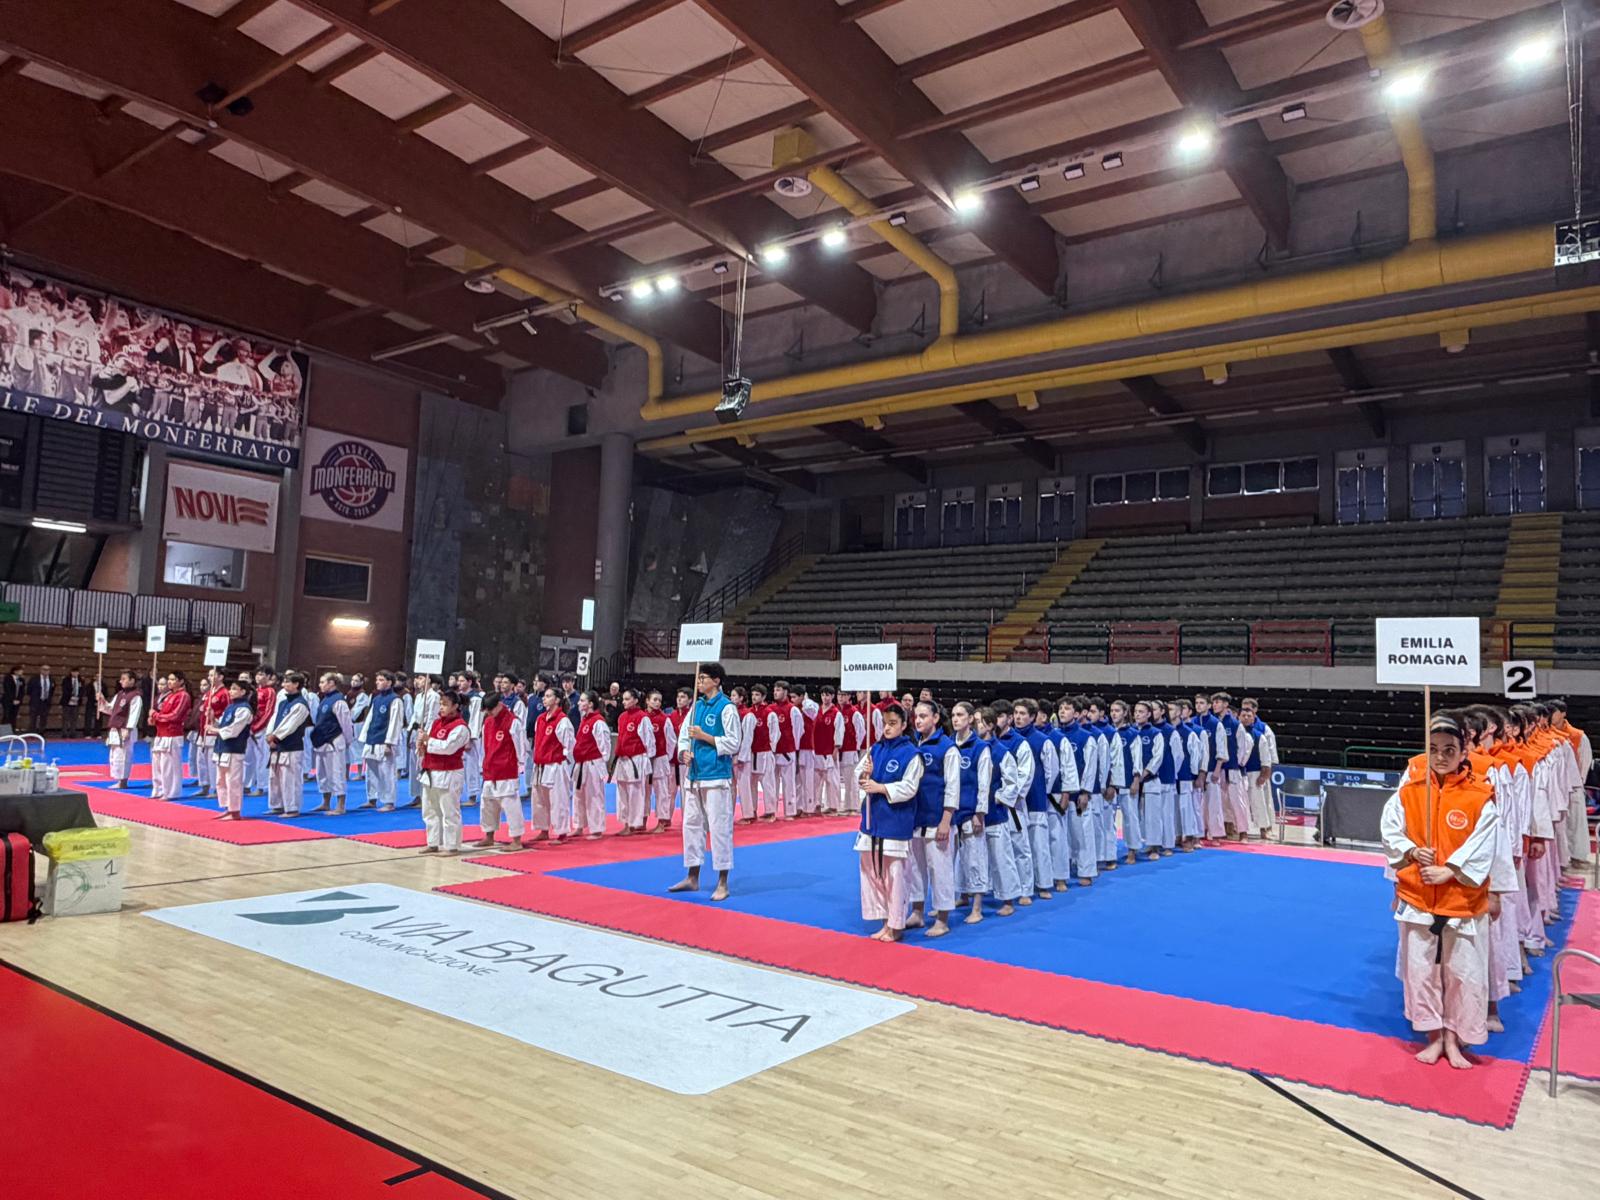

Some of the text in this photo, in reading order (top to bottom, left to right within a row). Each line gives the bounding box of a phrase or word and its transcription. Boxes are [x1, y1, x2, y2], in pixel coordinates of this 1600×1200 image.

[53, 404, 108, 428] DEL
[122, 416, 292, 464] MONFERRATO
[337, 444, 375, 461] BASKET
[314, 466, 392, 490] MONFERRATO
[686, 637, 714, 647] MARCHE
[1400, 637, 1454, 649] EMILIA
[466, 654, 473, 668] 4
[579, 656, 587, 671] 3
[843, 663, 894, 671] LOMBARDIA
[1388, 654, 1468, 666] ROMAGNA
[1506, 666, 1534, 693] 2
[104, 859, 118, 877] 1
[339, 930, 498, 976] COMUNICAZIONE
[371, 916, 811, 1043] VIA BAGUTTA
